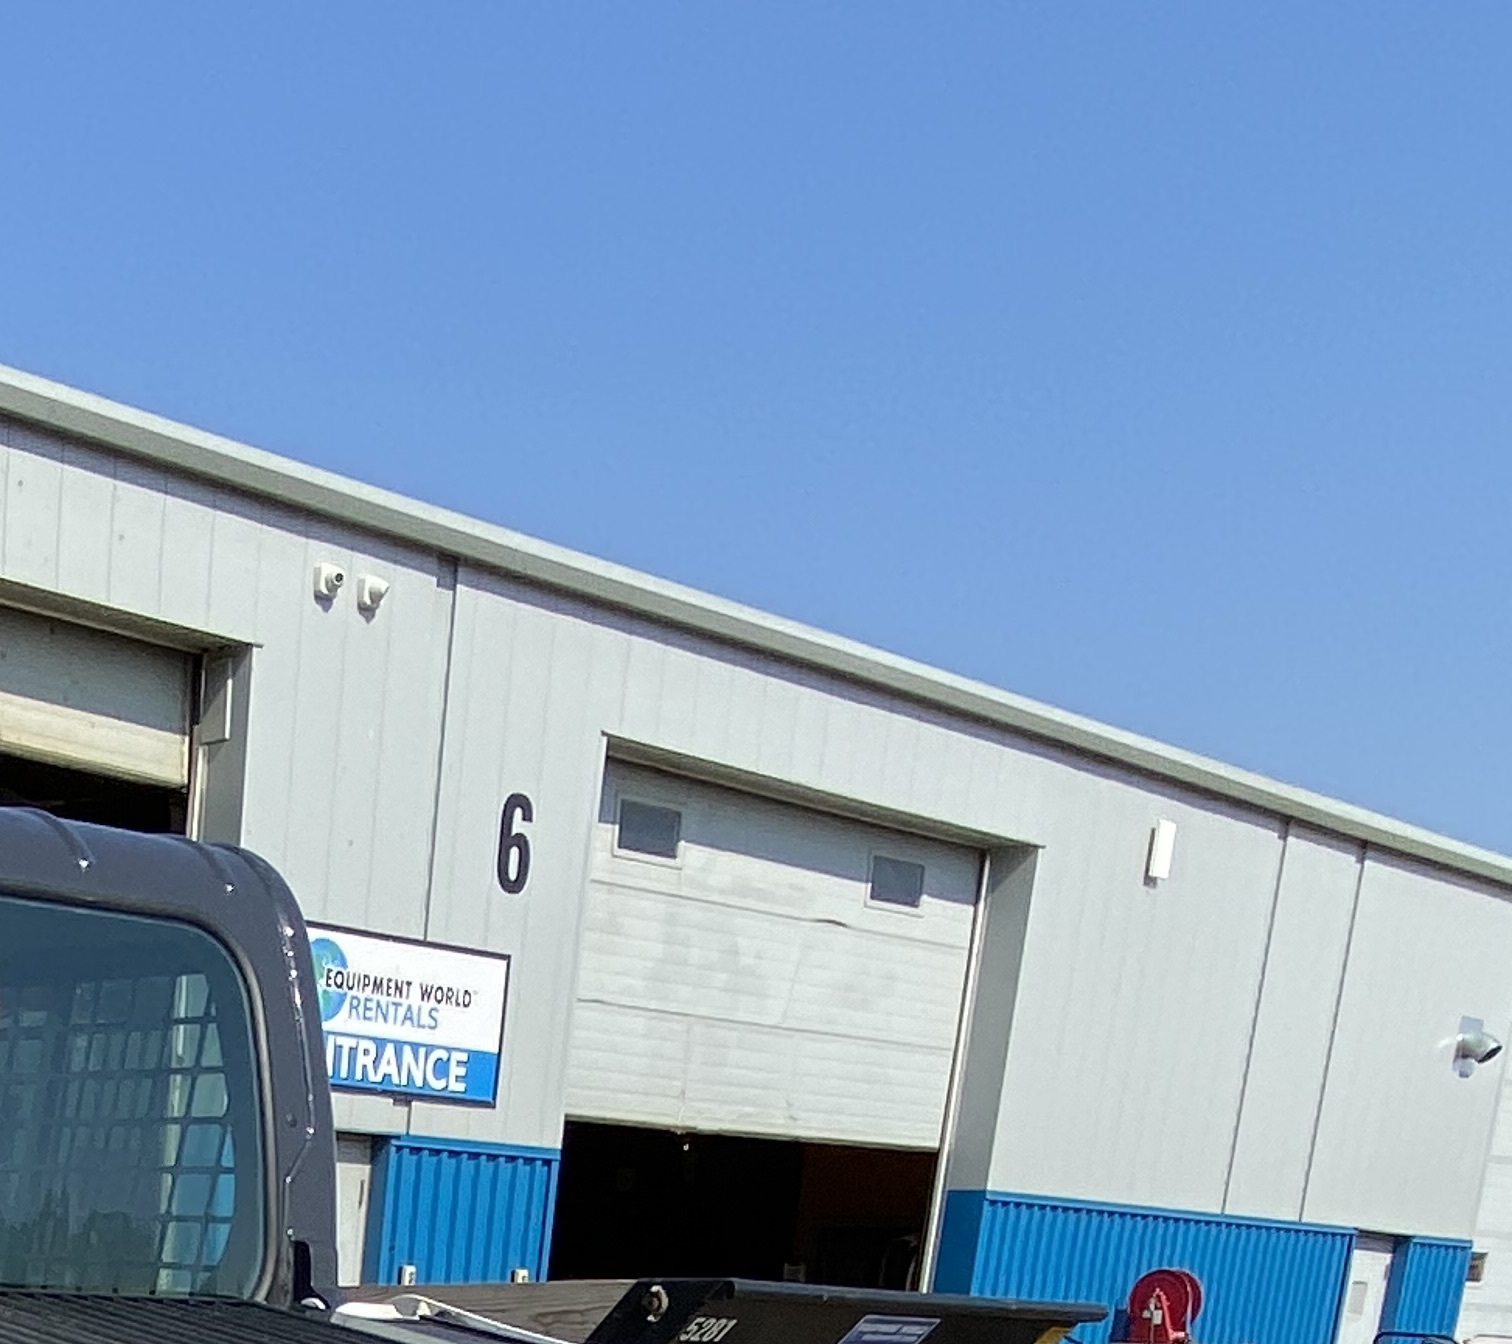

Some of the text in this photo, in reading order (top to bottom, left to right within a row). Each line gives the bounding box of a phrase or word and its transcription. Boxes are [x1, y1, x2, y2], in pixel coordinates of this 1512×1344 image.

[496, 792, 534, 895] 6
[325, 967, 472, 1008] EQUIPMENT WORLD
[348, 996, 439, 1031] RENTALS
